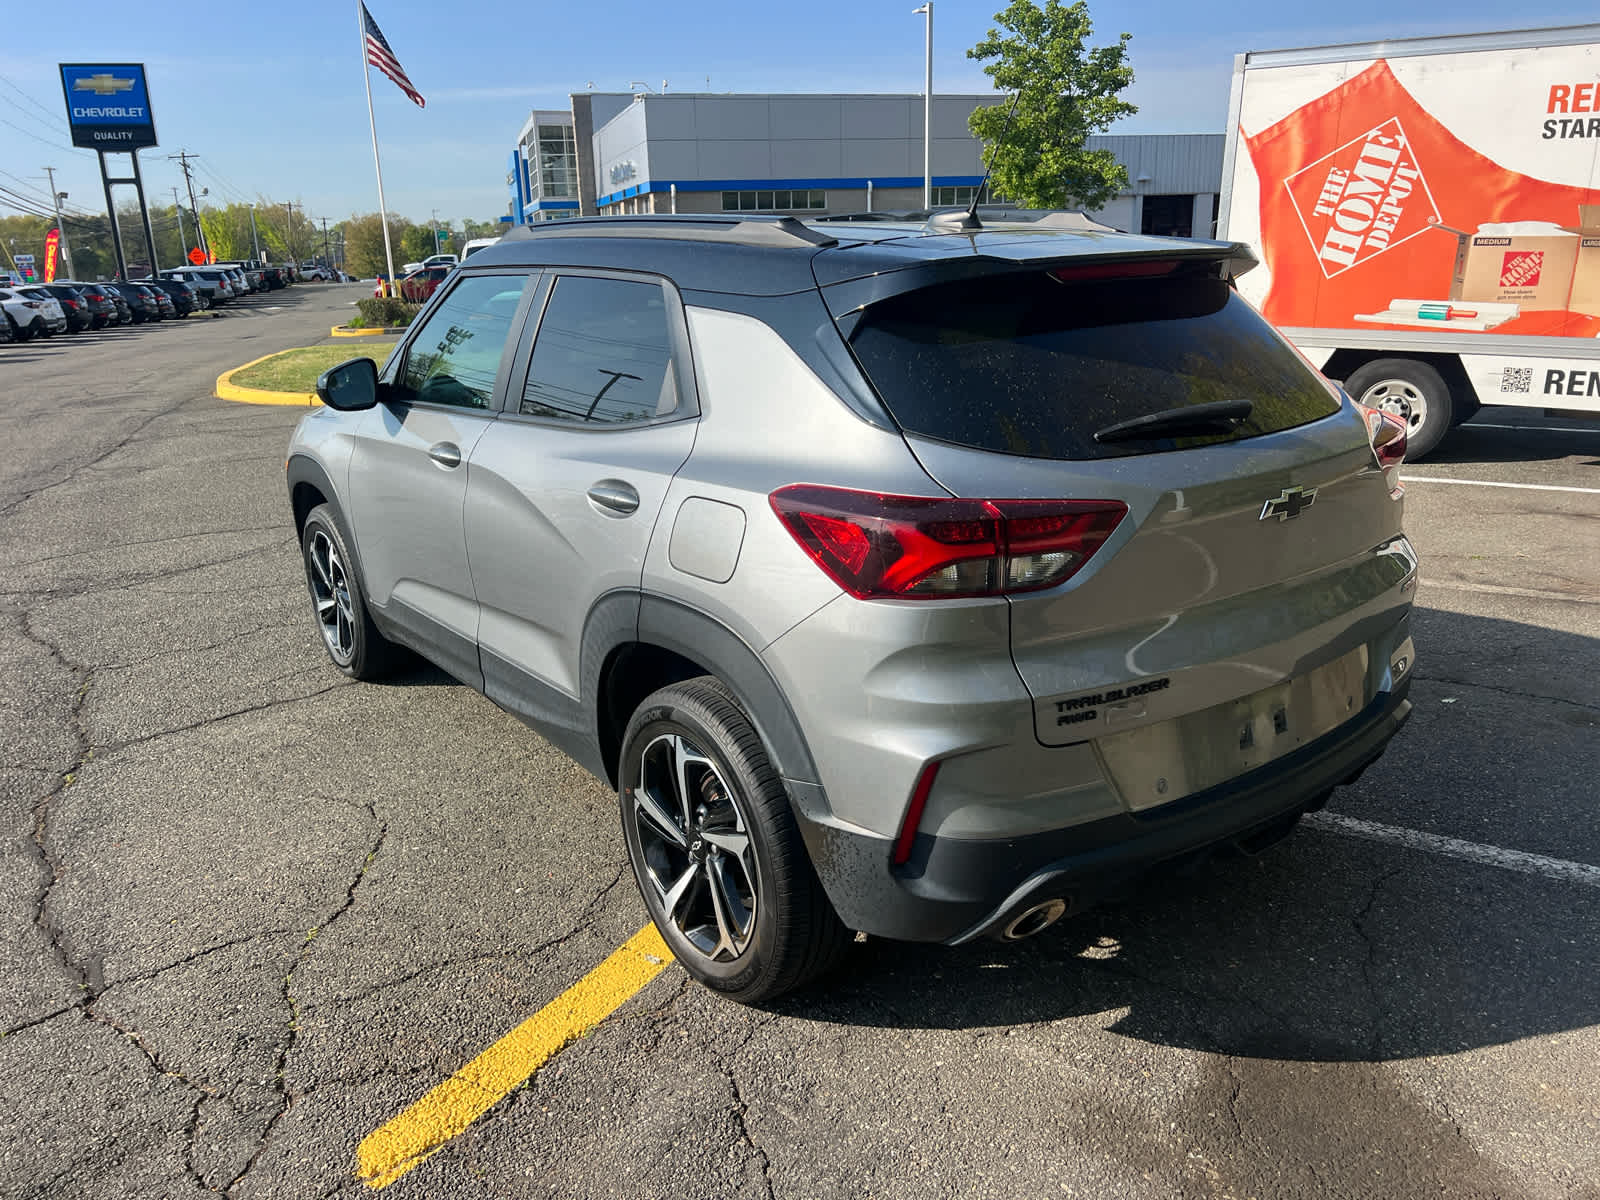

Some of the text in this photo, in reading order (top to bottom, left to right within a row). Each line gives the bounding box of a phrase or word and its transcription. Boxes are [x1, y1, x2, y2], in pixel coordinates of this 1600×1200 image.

[73, 107, 144, 118] CHEVROLET
[1546, 82, 1600, 114] RE
[94, 131, 133, 140] QUALITY
[1312, 166, 1350, 217] THE
[1320, 129, 1406, 267] HOME
[1365, 161, 1420, 249] DEPOT
[1501, 252, 1542, 286] HOME
[1507, 256, 1523, 269] THE
[1515, 265, 1541, 286] DEPOT
[1055, 678, 1170, 712] TRAILBLAZER
[1057, 710, 1097, 727] AWD
